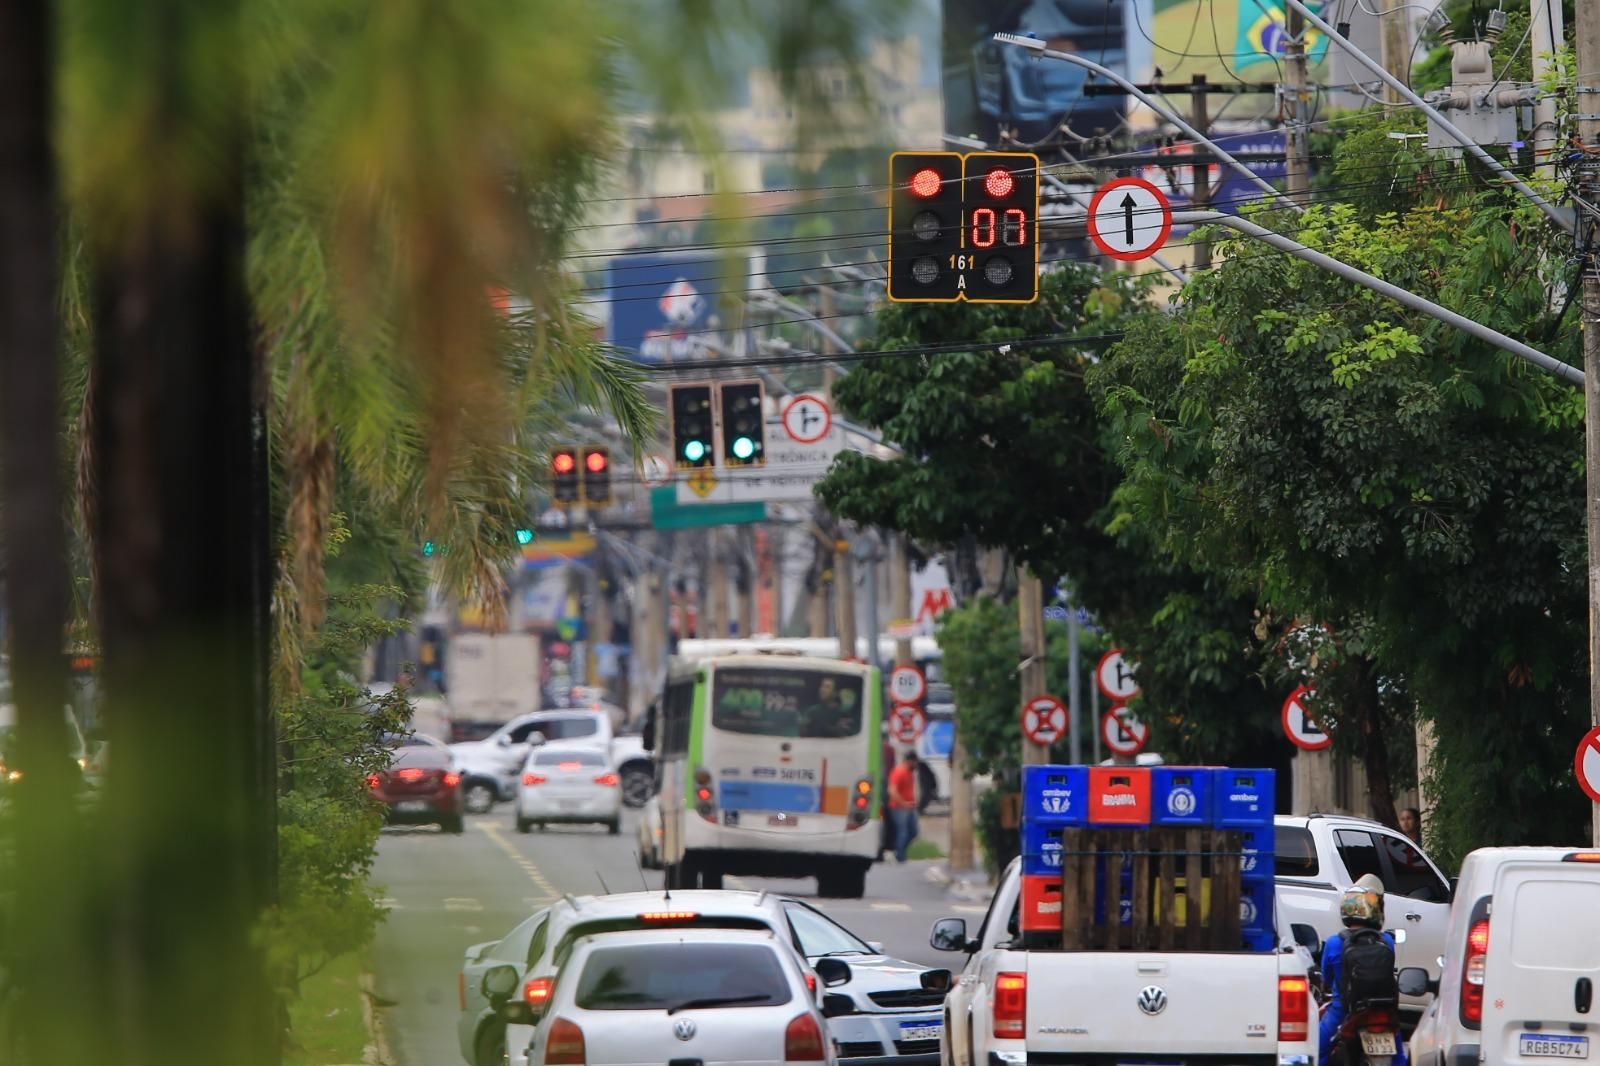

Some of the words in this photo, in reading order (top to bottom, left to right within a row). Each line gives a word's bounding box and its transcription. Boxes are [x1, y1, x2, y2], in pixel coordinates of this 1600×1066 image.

[972, 208, 1026, 247] 07
[949, 254, 975, 270] 161
[957, 274, 966, 289] A
[1042, 788, 1072, 798] ambev
[1229, 793, 1259, 802] ambev
[1526, 1041, 1581, 1056] RGB5C74
